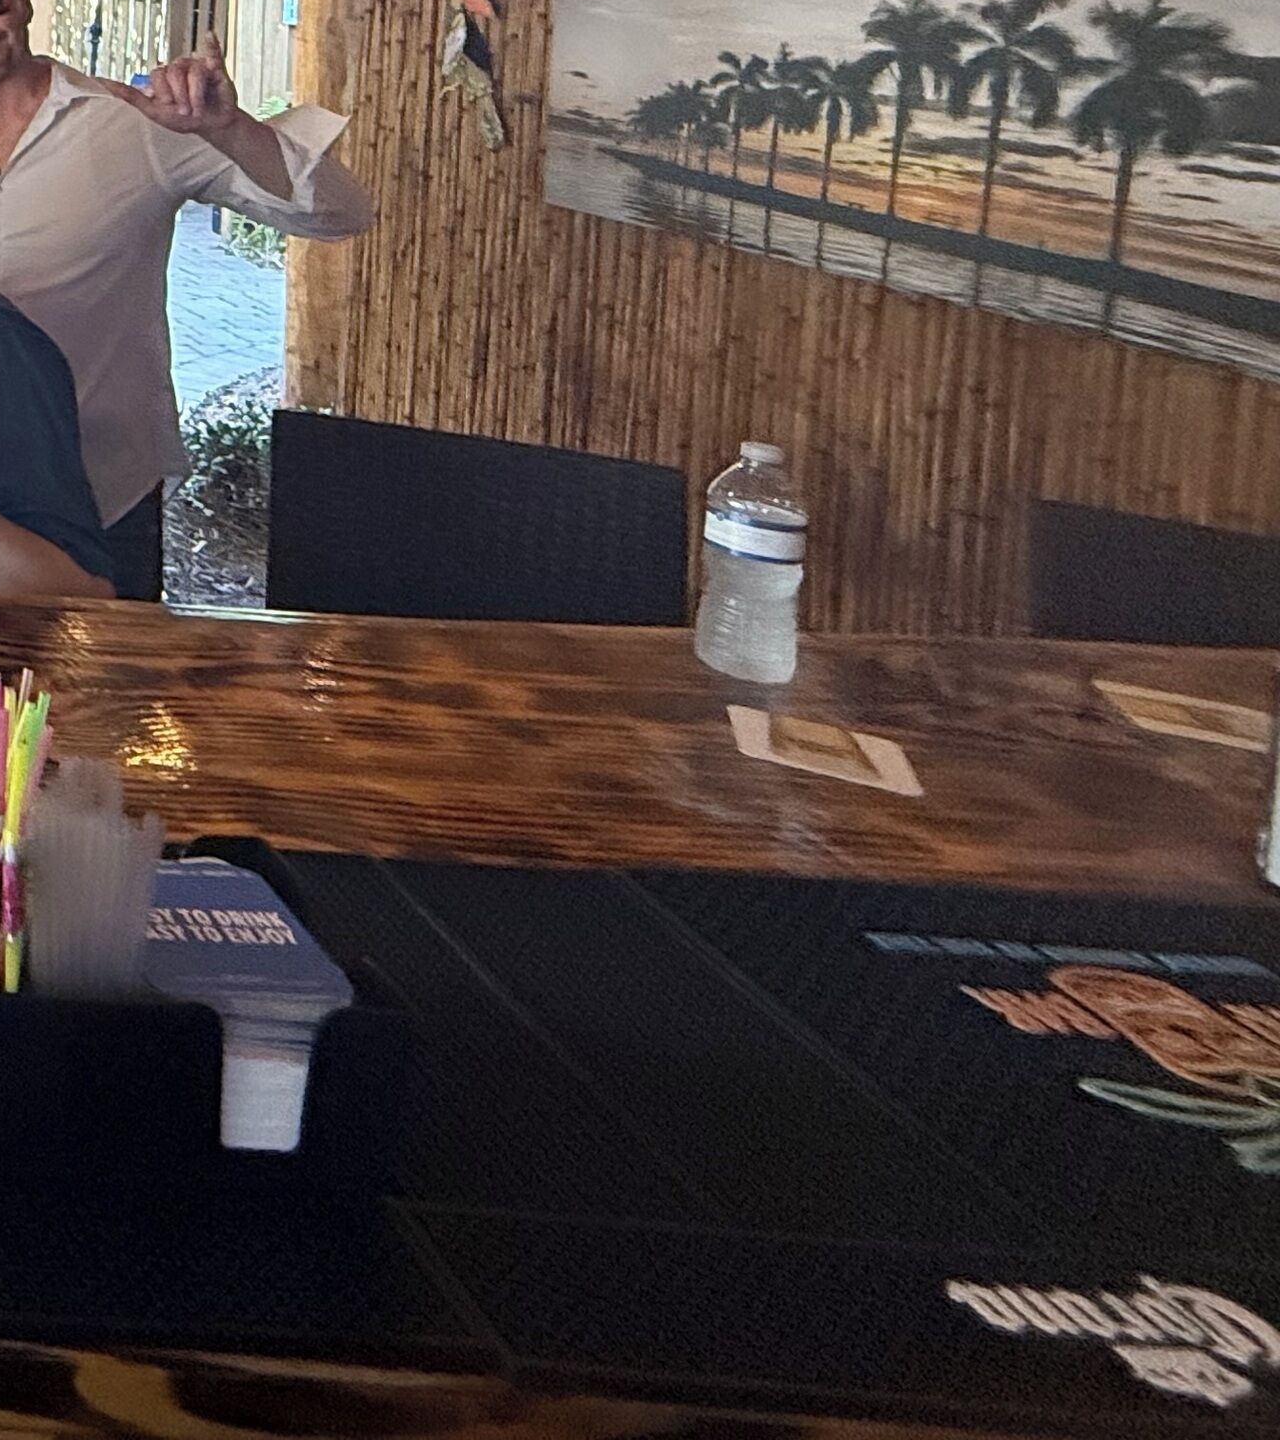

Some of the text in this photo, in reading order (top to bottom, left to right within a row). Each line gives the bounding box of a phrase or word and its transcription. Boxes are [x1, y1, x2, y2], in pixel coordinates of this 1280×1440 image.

[176, 908, 213, 926] TO
[212, 910, 291, 929] DRINK
[144, 924, 298, 945] ASY TO ENJOY
[943, 1273, 1280, 1368] Corona
